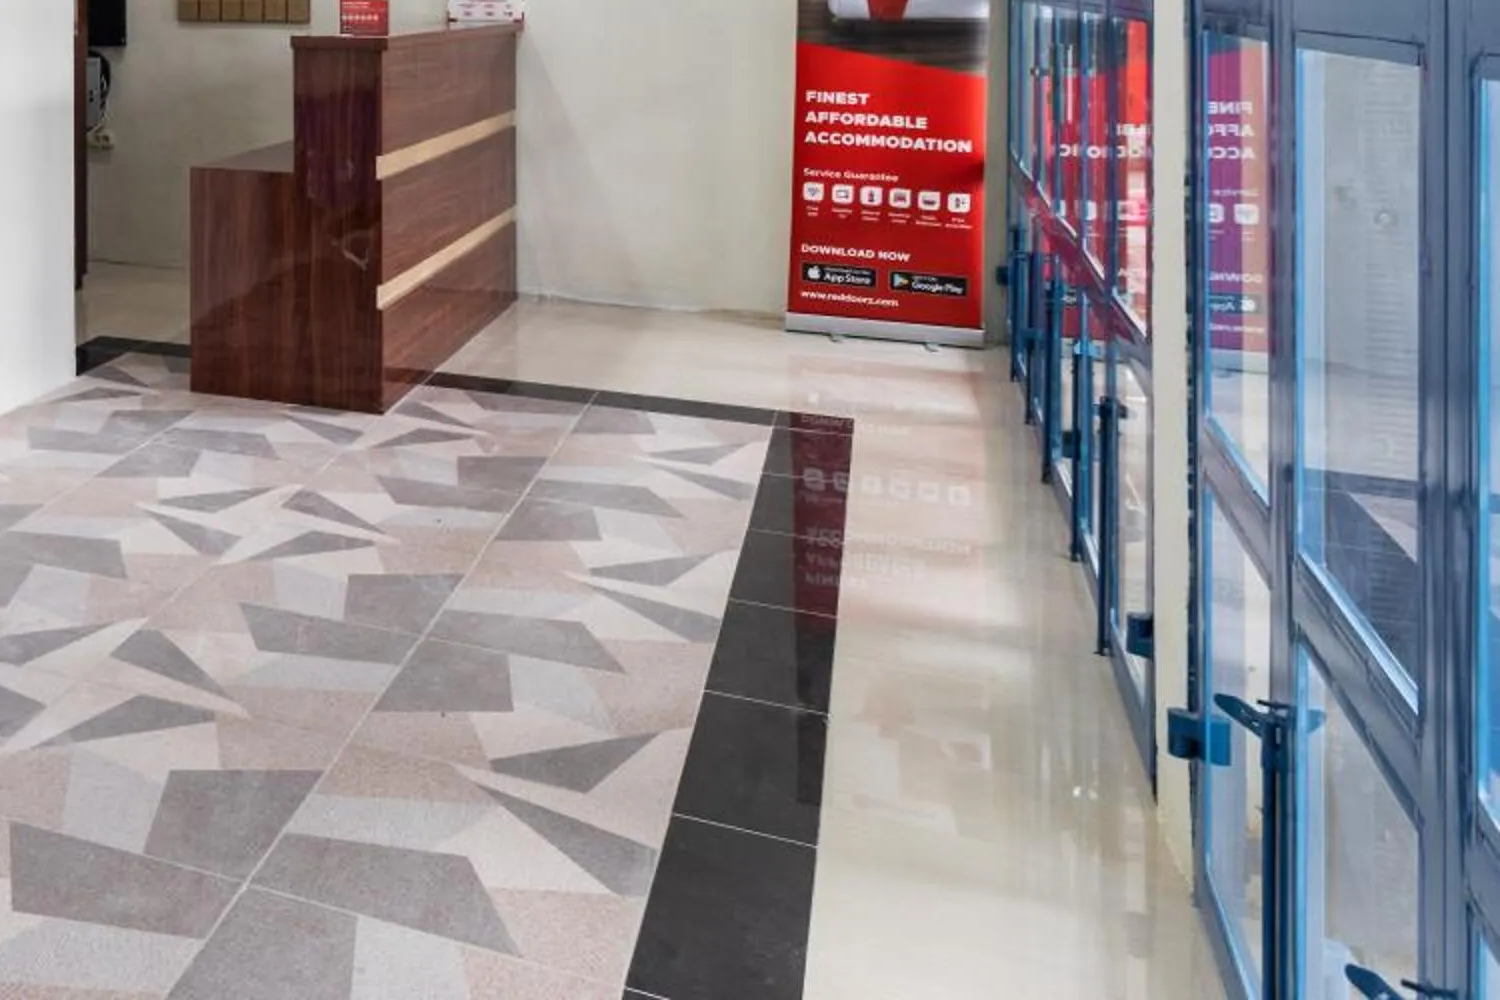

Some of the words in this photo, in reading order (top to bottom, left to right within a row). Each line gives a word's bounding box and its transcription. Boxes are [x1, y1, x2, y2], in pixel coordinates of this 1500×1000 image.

[805, 90, 870, 105] FINEST
[804, 111, 928, 130] AFFORDABLE
[804, 131, 973, 153] ACCOMMODATION
[803, 167, 841, 178] Service
[843, 170, 899, 182] Guarantee
[801, 243, 875, 259] DOWNLOAD
[877, 250, 911, 262] NOW
[823, 272, 845, 284] App
[846, 274, 872, 285] Store
[911, 281, 943, 293] Google
[944, 283, 965, 294] Play
